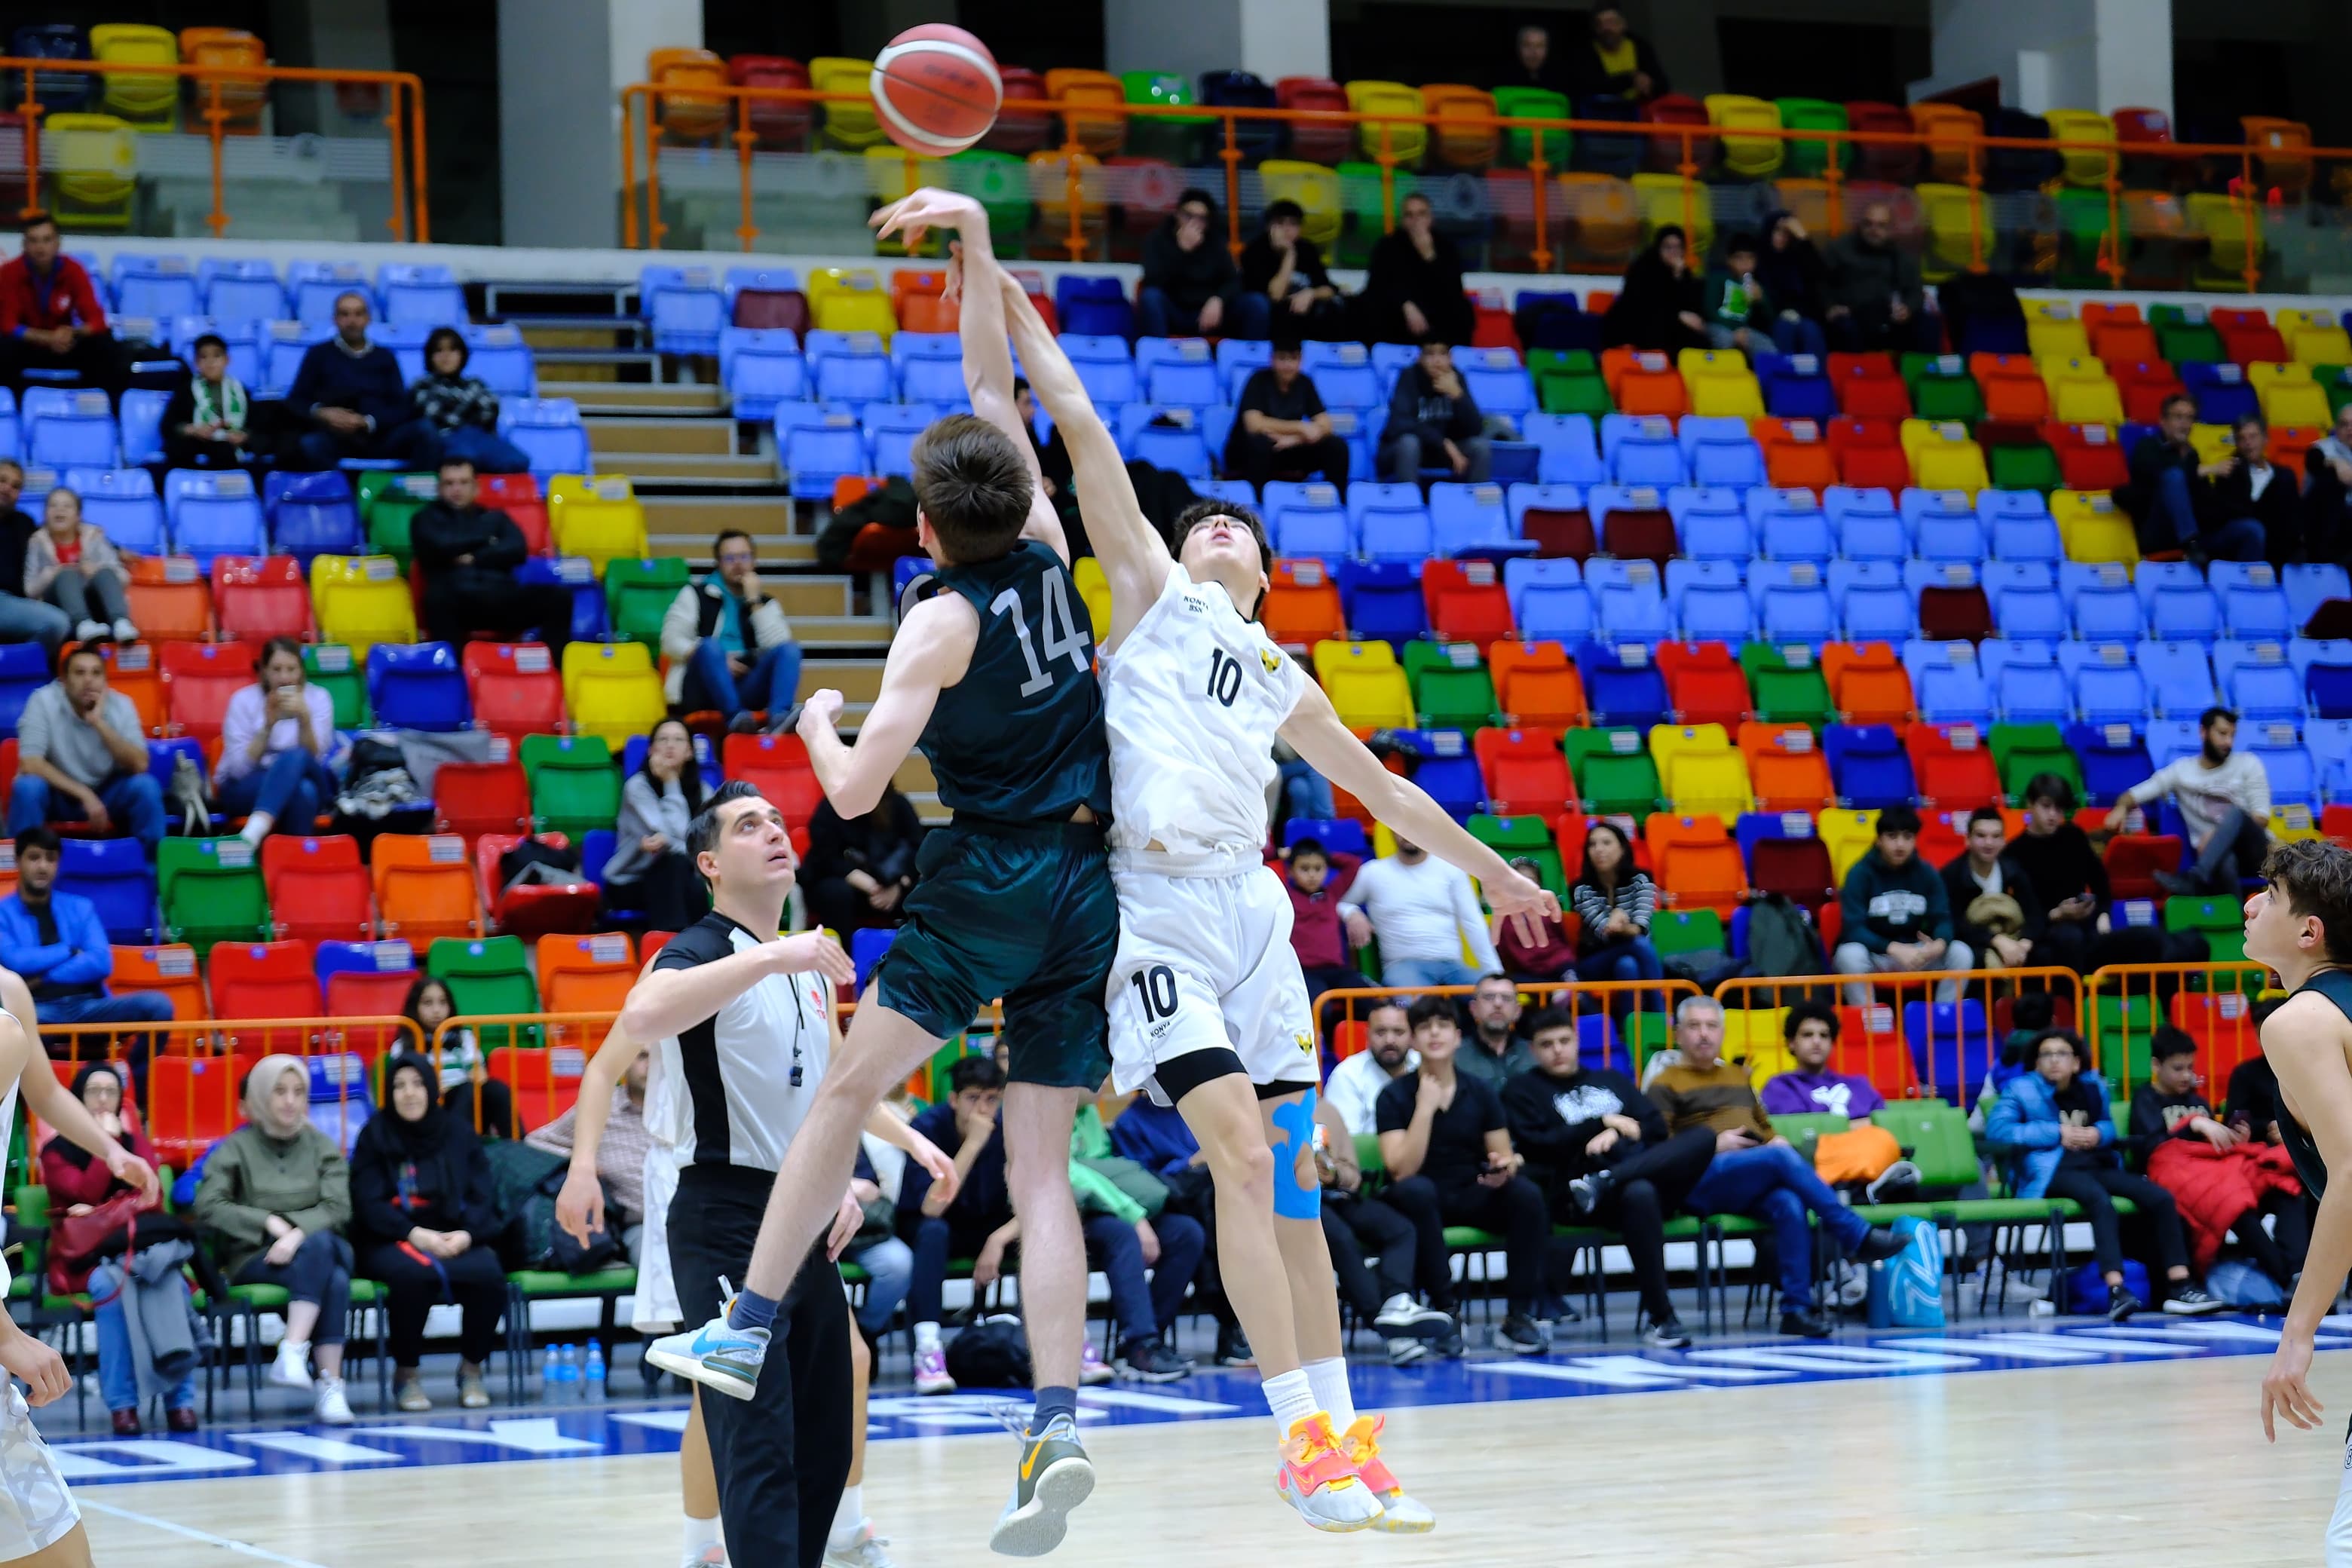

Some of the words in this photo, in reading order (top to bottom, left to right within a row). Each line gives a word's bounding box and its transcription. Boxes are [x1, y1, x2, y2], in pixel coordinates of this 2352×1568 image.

[990, 565, 1090, 698] 14
[1208, 648, 1243, 707] 10
[1132, 965, 1178, 1024] 10
